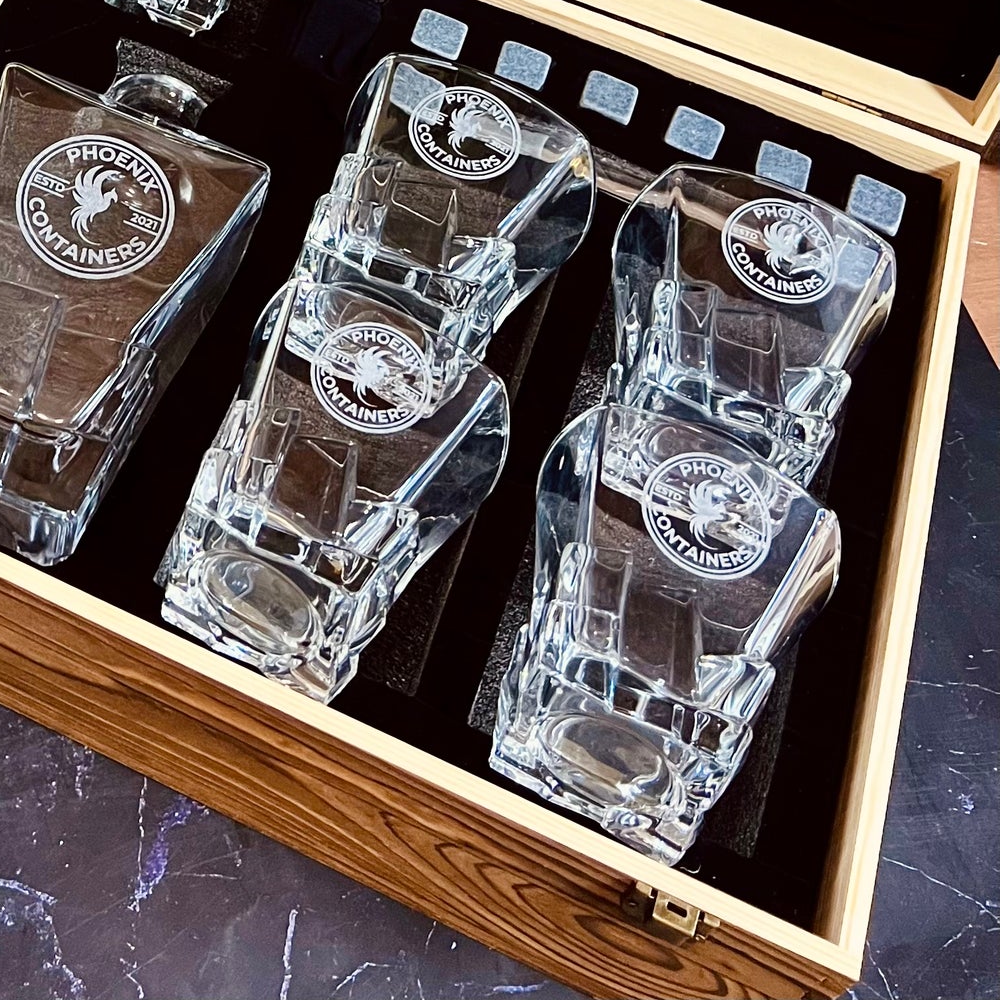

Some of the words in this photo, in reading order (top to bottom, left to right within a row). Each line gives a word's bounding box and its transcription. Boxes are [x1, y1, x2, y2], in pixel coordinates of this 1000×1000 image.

[445, 93, 511, 129] PHOENIX
[66, 145, 160, 194] PHOENIX
[417, 124, 501, 171] CONTAINERS
[33, 173, 66, 193] ESTD
[28, 196, 147, 265] CONTAINERS
[129, 213, 159, 231] 2021
[753, 205, 829, 249] PHOENIX
[732, 242, 823, 294] CONTAINERS
[654, 484, 683, 501] ESTD
